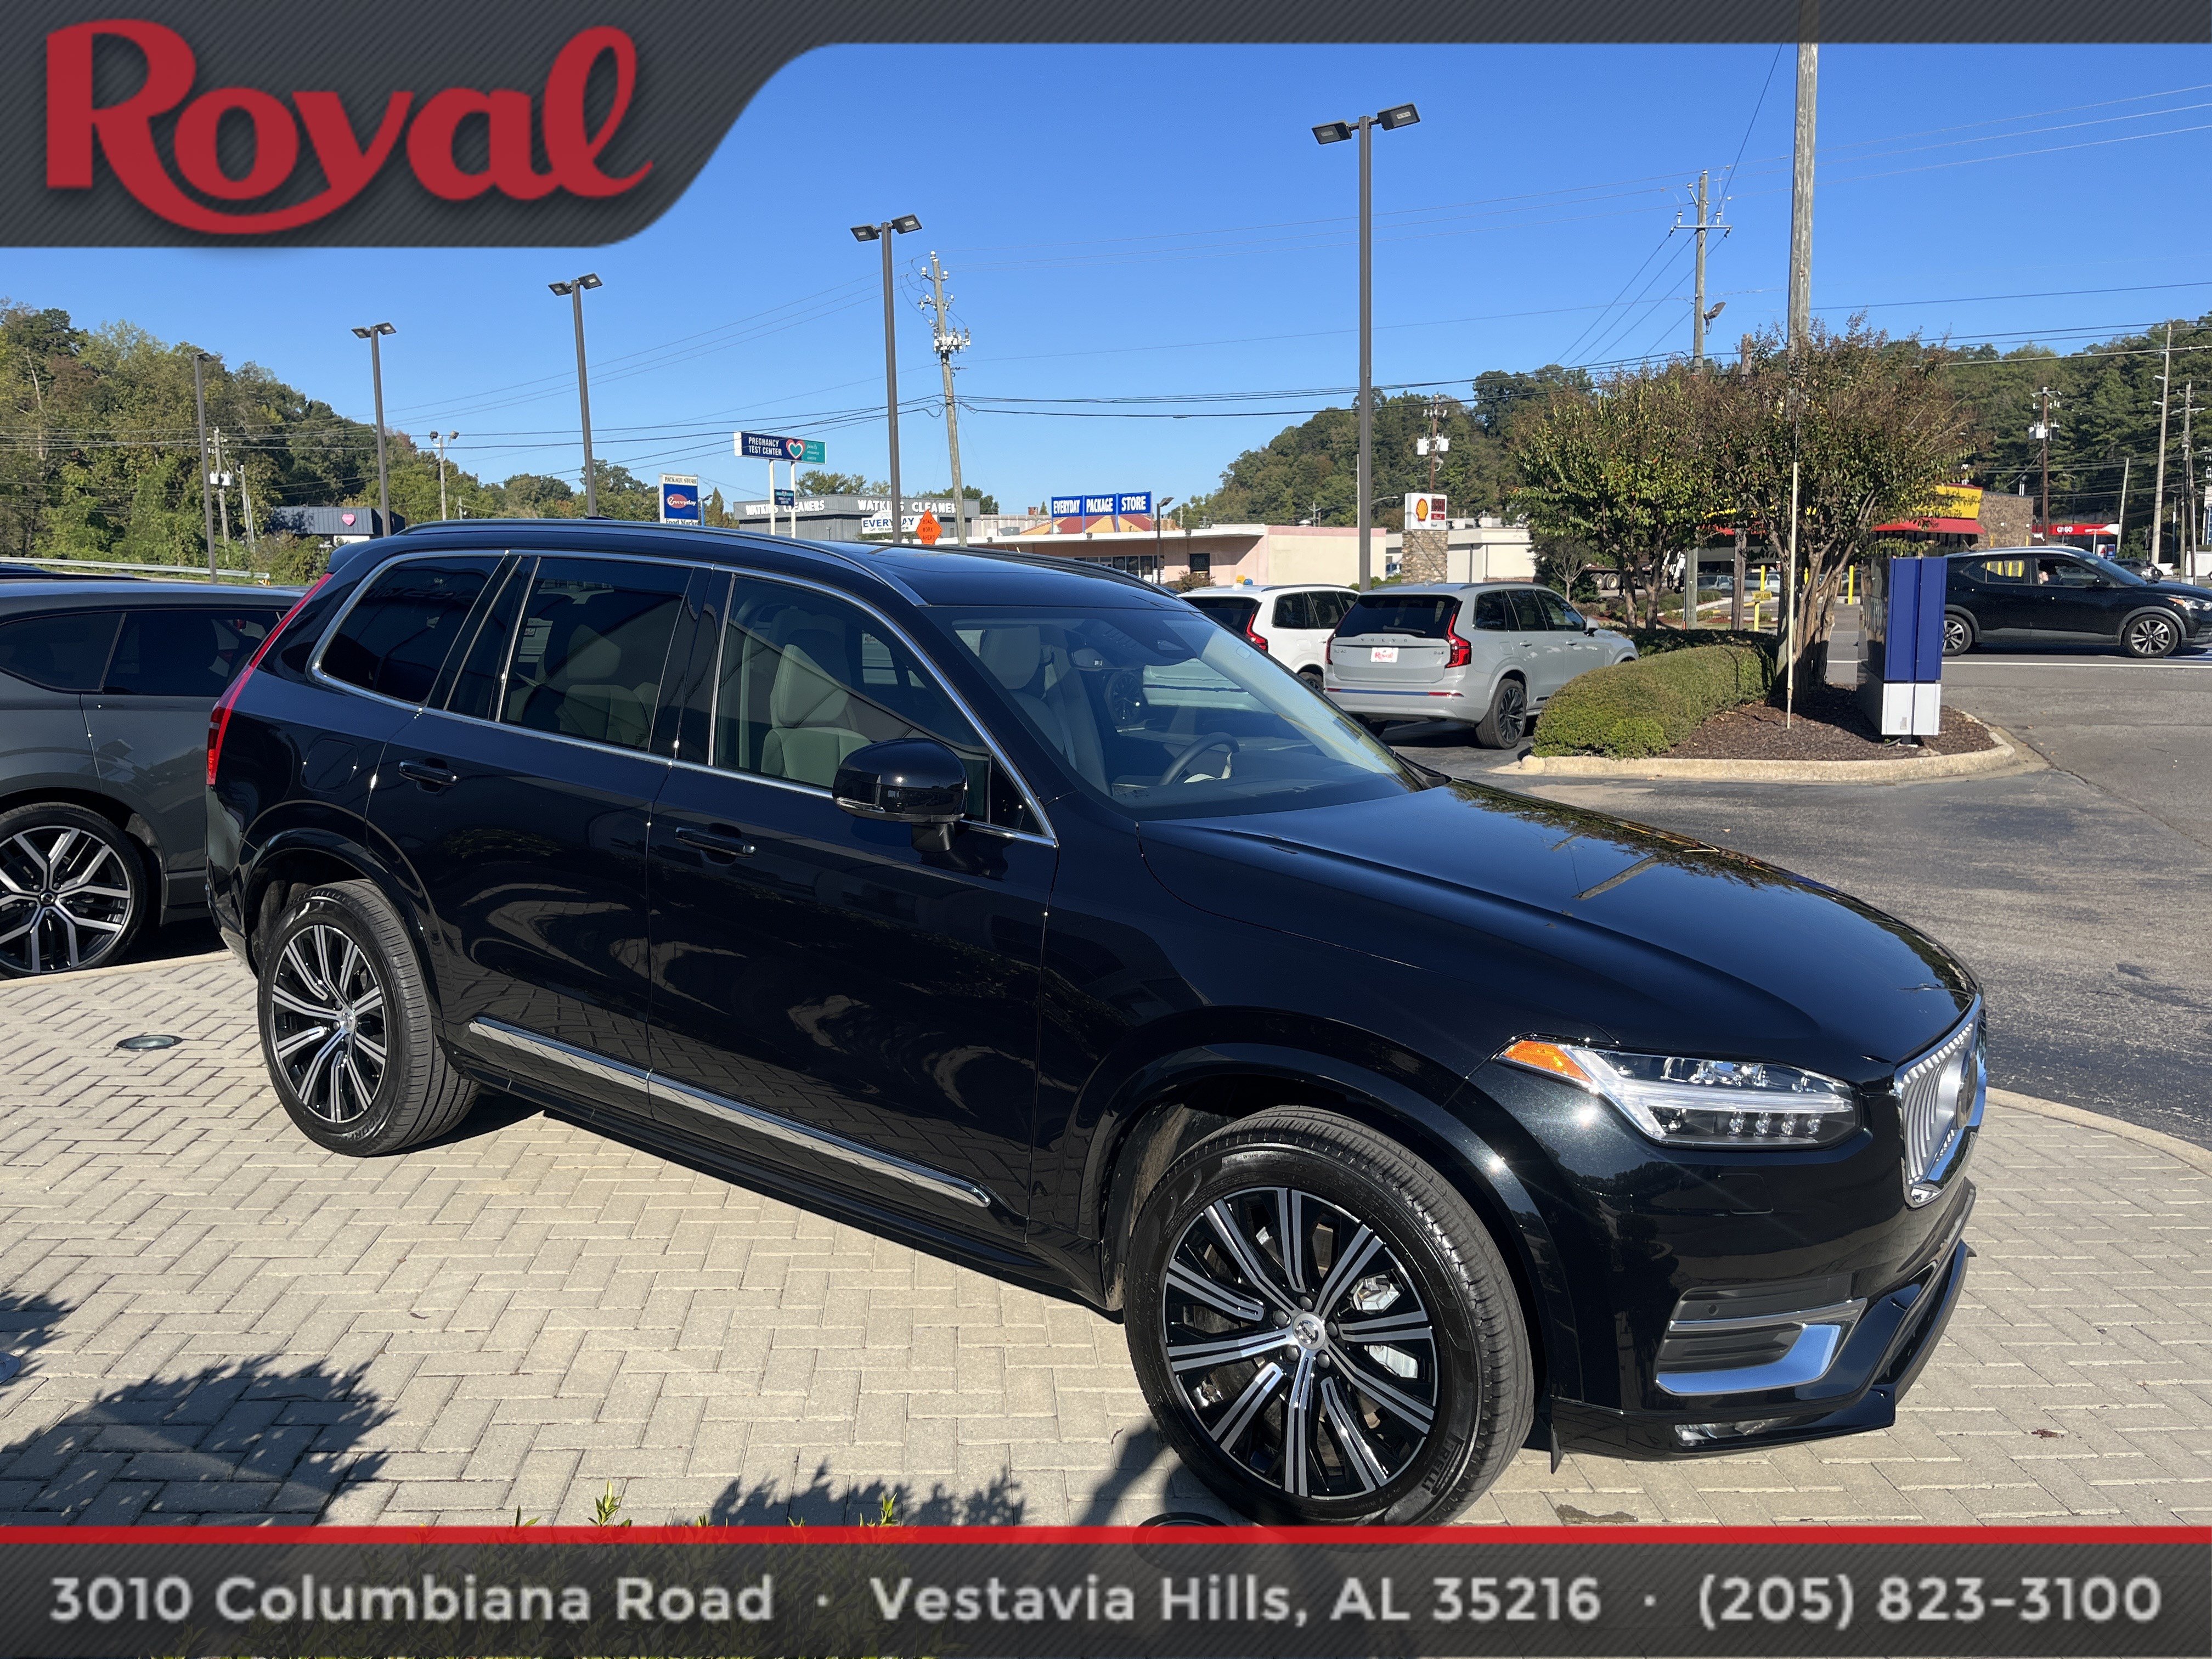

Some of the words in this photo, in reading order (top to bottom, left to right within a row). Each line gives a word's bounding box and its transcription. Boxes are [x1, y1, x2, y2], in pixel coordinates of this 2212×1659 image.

[748, 437, 780, 447] PREGNANCY
[749, 445, 761, 454] TEST
[763, 447, 782, 456] CENTER
[857, 500, 905, 512] WATKIS
[1053, 499, 1080, 514] EVERYDAY
[1086, 498, 1113, 513] PACKAGE
[1121, 495, 1146, 511] STORE
[863, 517, 914, 527] EVERYAY
[1421, 1431, 1465, 1496] PIRELLI
